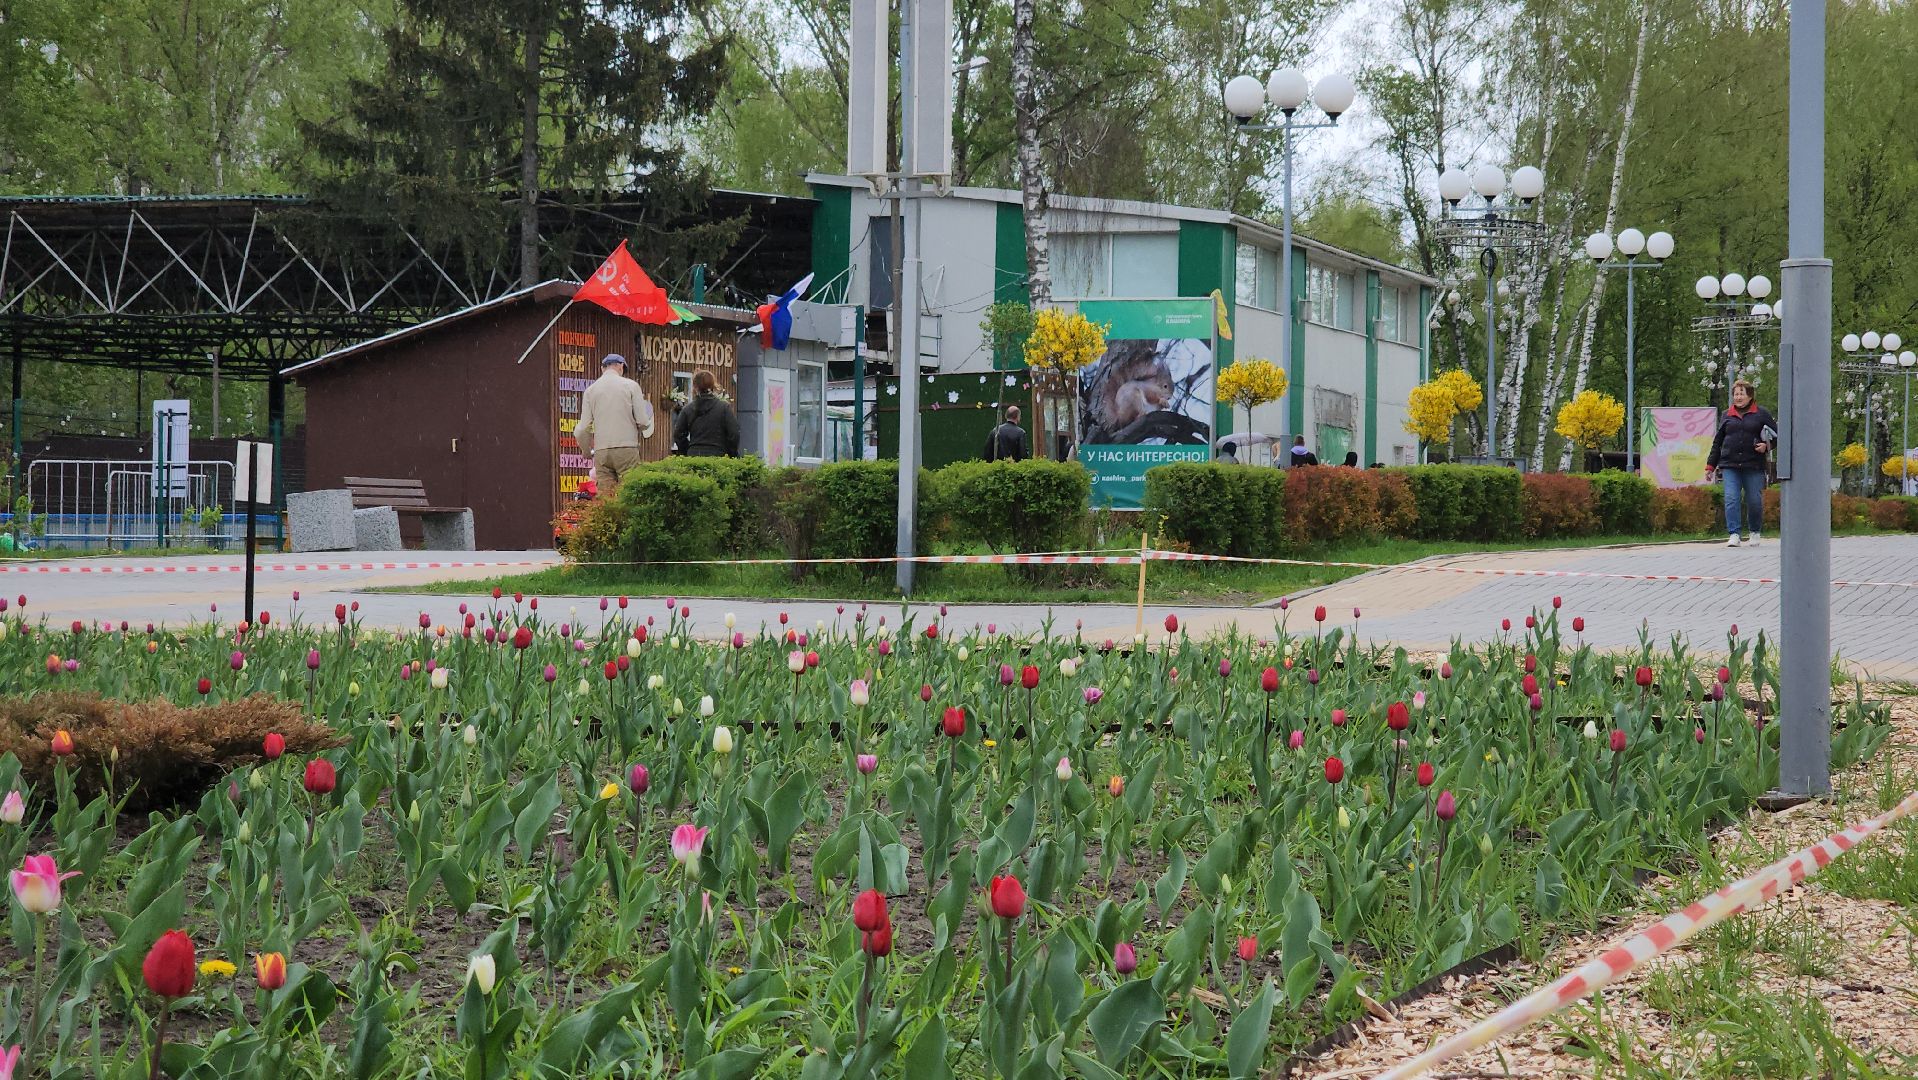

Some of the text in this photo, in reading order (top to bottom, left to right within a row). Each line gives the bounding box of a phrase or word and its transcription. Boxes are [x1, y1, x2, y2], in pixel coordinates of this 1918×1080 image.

[559, 331, 595, 348] ПОНЧИКИ
[641, 334, 733, 368] МОРОЖЕНОЕ
[559, 353, 584, 373] КОФЕ
[559, 394, 578, 413] ЧАЙ
[1088, 451, 1205, 462] У НАС ИНТЕРЕСНО!
